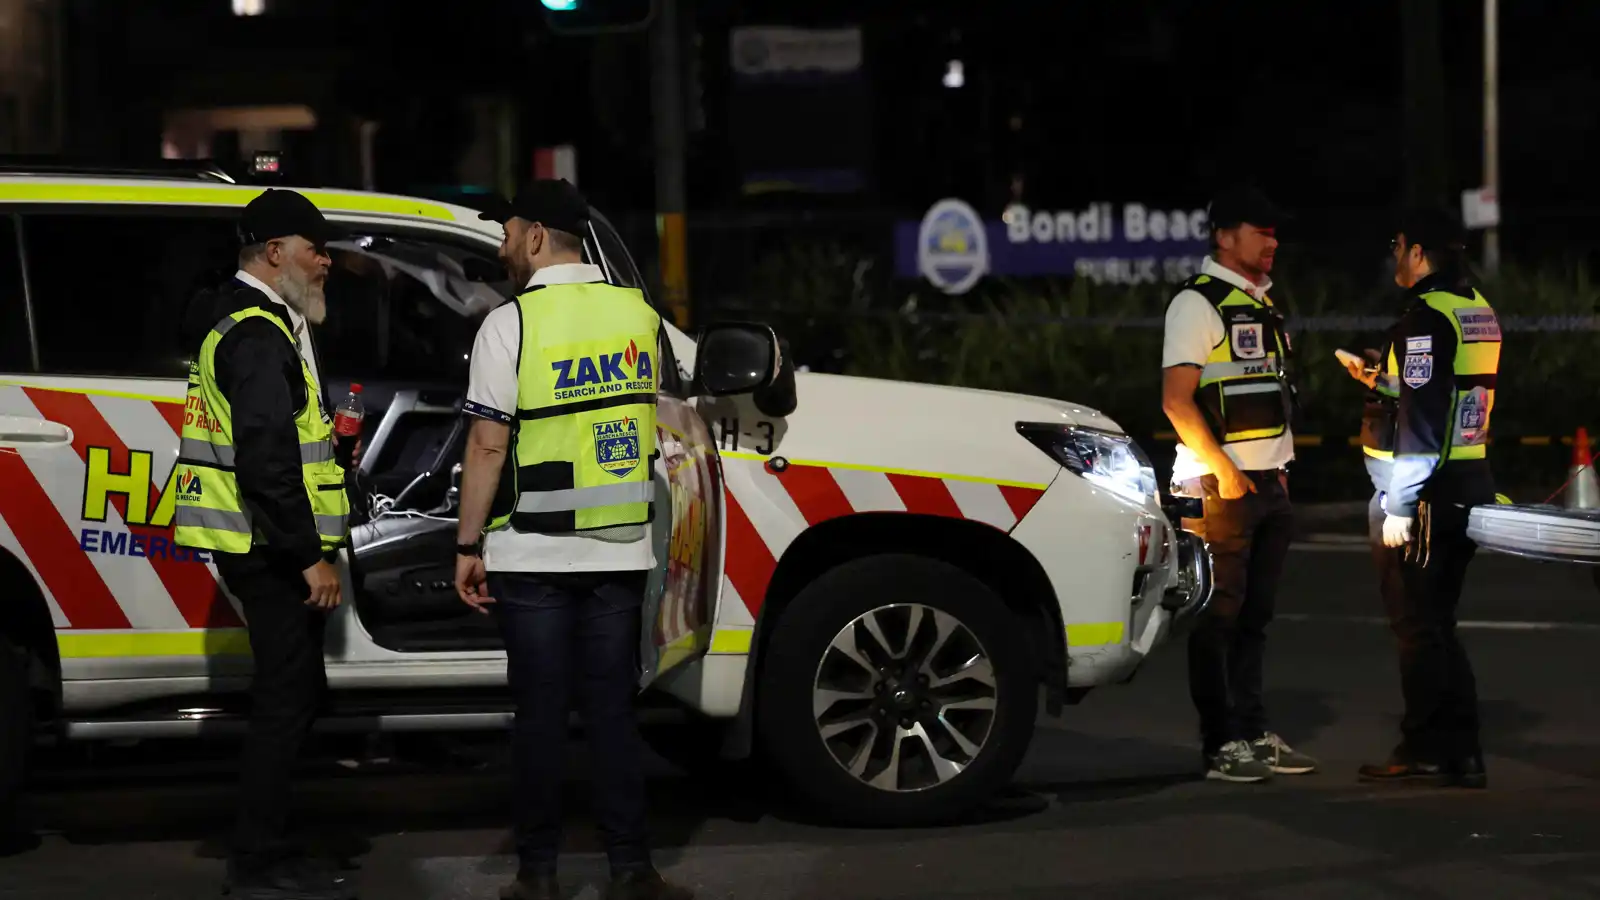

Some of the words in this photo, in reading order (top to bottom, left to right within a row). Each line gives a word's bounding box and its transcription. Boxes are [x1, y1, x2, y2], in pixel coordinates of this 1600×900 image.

[1006, 202, 1112, 242] Bondi
[1123, 203, 1211, 241] Beac
[552, 351, 652, 389] ZAKA
[554, 387, 596, 400] SEARCH
[599, 383, 622, 393] AND
[626, 381, 652, 390] RESCUE
[595, 420, 636, 435] ZAKA
[721, 417, 774, 455] H-3
[80, 528, 215, 564] EMERGE
